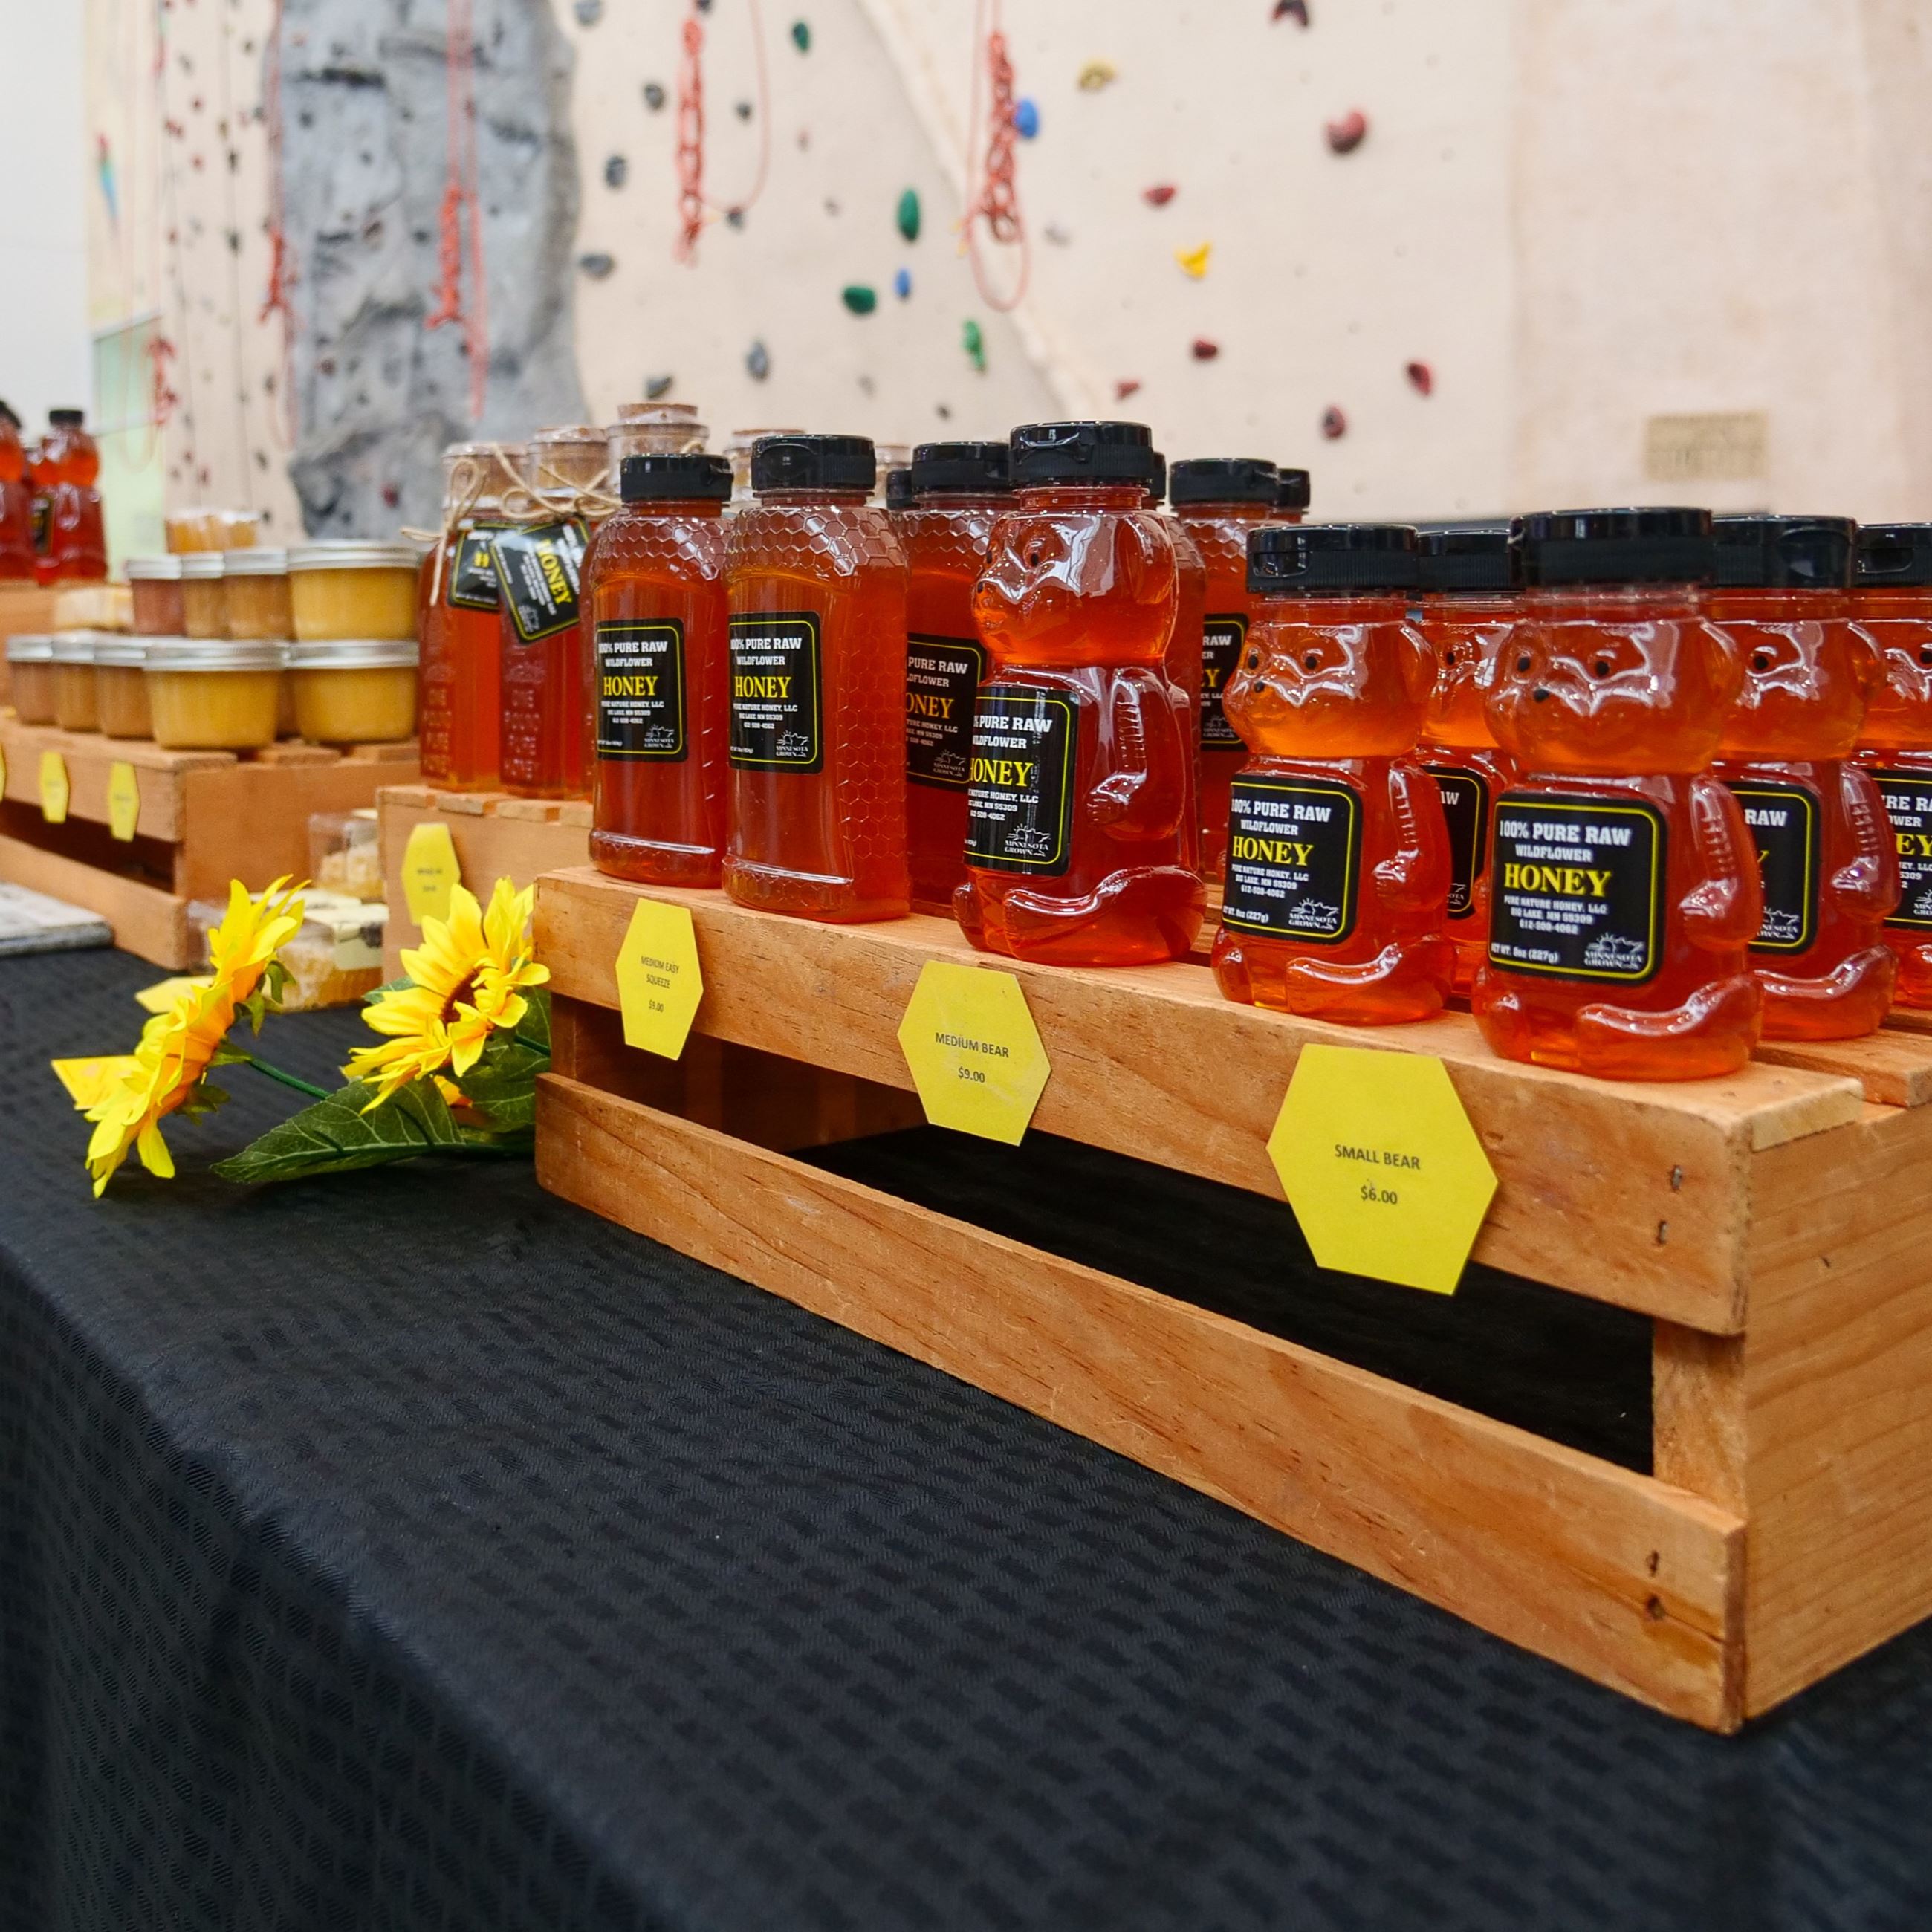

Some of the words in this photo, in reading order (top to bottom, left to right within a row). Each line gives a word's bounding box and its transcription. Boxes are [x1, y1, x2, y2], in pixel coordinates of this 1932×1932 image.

[614, 642, 639, 653] PURE
[641, 641, 668, 652] RAW
[745, 638, 771, 650] PURE
[773, 637, 802, 650] RAW
[1202, 635, 1232, 646] RAW
[605, 658, 653, 667] WILDFLOWER
[736, 655, 785, 666] WILDFLOWER
[908, 656, 936, 671] PURE
[938, 661, 968, 675] RAW
[603, 676, 658, 696] HONEY
[735, 675, 791, 698] HONEY
[906, 673, 950, 688] DFLOWER
[906, 692, 954, 719] ONEY
[944, 725, 959, 733] LLC
[979, 715, 1009, 730] PURE
[1012, 716, 1053, 733] RAW
[1019, 794, 1039, 803] LLC
[1882, 795, 1910, 811] RE
[1916, 797, 1932, 812] RA
[1254, 800, 1290, 818] PURE
[1293, 805, 1332, 823] RAW
[1745, 808, 1787, 827] RAW
[1240, 819, 1299, 836] WILDFLOWER
[1500, 820, 1529, 839] 100%
[1532, 822, 1581, 843] PURE
[1585, 826, 1633, 846] RAW
[1004, 846, 1033, 855] GROWN
[1005, 840, 1049, 851] MINNESOTA
[1232, 835, 1314, 866] HONEY
[1514, 843, 1594, 863] WILDFLOWER
[1293, 872, 1309, 882] LLC
[1503, 863, 1612, 898] HONEY
[1899, 871, 1922, 881] 5309
[1520, 897, 1551, 910] NATURE
[1588, 903, 1608, 915] LLC
[1288, 919, 1320, 929] GROWN
[1289, 913, 1337, 924] MINNESOTA
[1562, 912, 1594, 925] 55309
[1528, 948, 1559, 965] (227g)
[1585, 950, 1643, 963] MINNESOTA
[935, 1032, 979, 1051] MEDIUM
[981, 1043, 1009, 1058] BEAR
[958, 1066, 985, 1083] $9.00
[1335, 1144, 1380, 1164] SMALL
[1384, 1152, 1421, 1170] BEAR
[1361, 1184, 1398, 1205] $6.00
